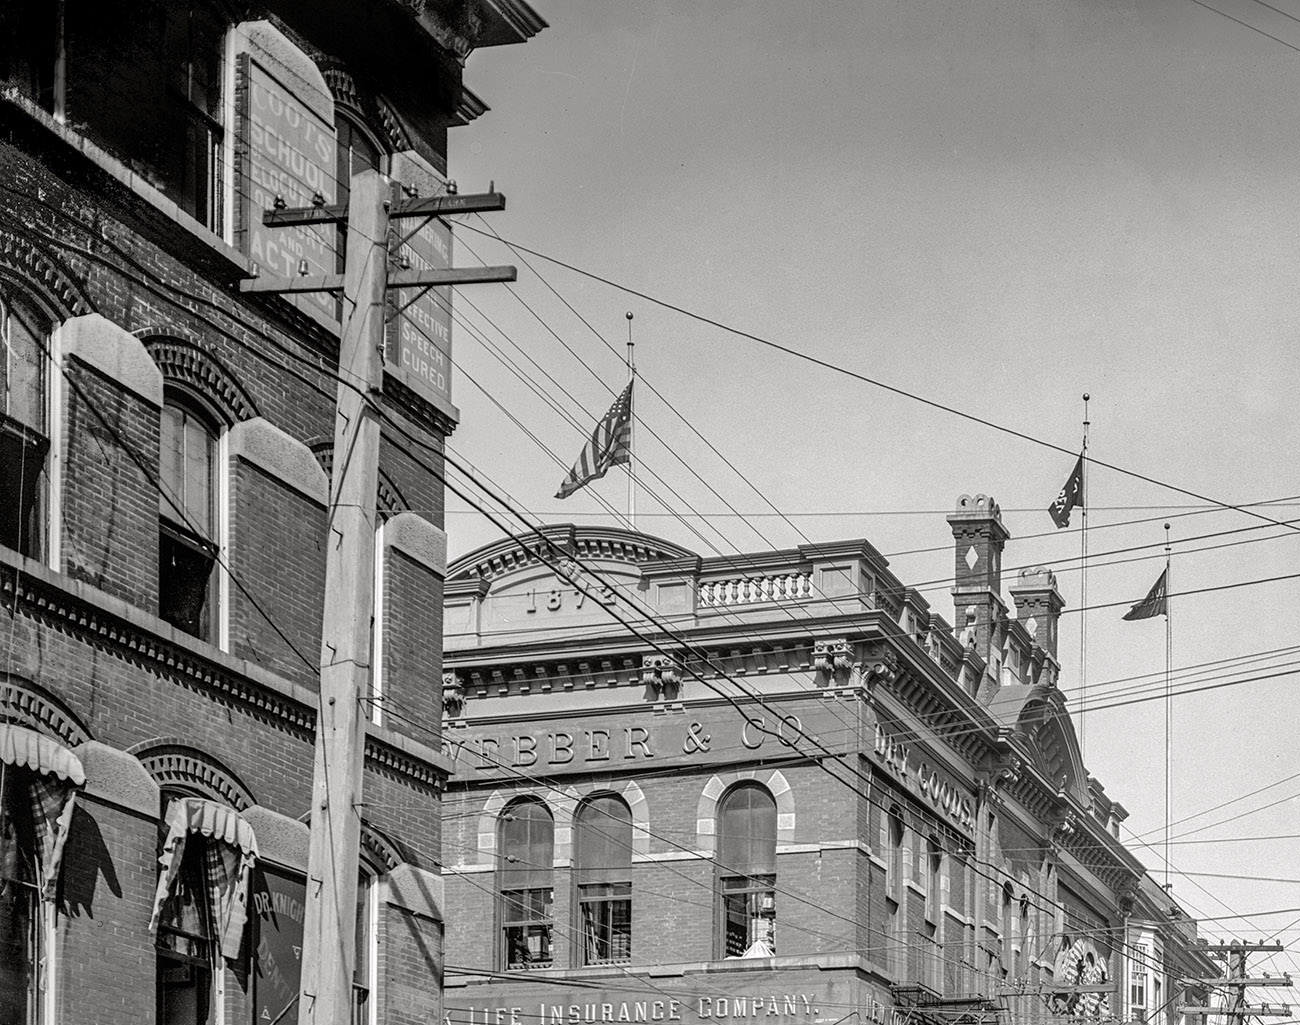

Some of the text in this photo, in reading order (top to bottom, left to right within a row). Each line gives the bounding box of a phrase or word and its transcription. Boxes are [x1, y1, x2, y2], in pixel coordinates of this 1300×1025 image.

[250, 112, 334, 208] SCHOOL
[402, 321, 444, 367] SPEECH
[402, 346, 449, 394] CURED.
[682, 722, 712, 755] &
[874, 720, 910, 778] DRY
[272, 891, 305, 925] KNIGH
[698, 994, 820, 1019] COMPANY.
